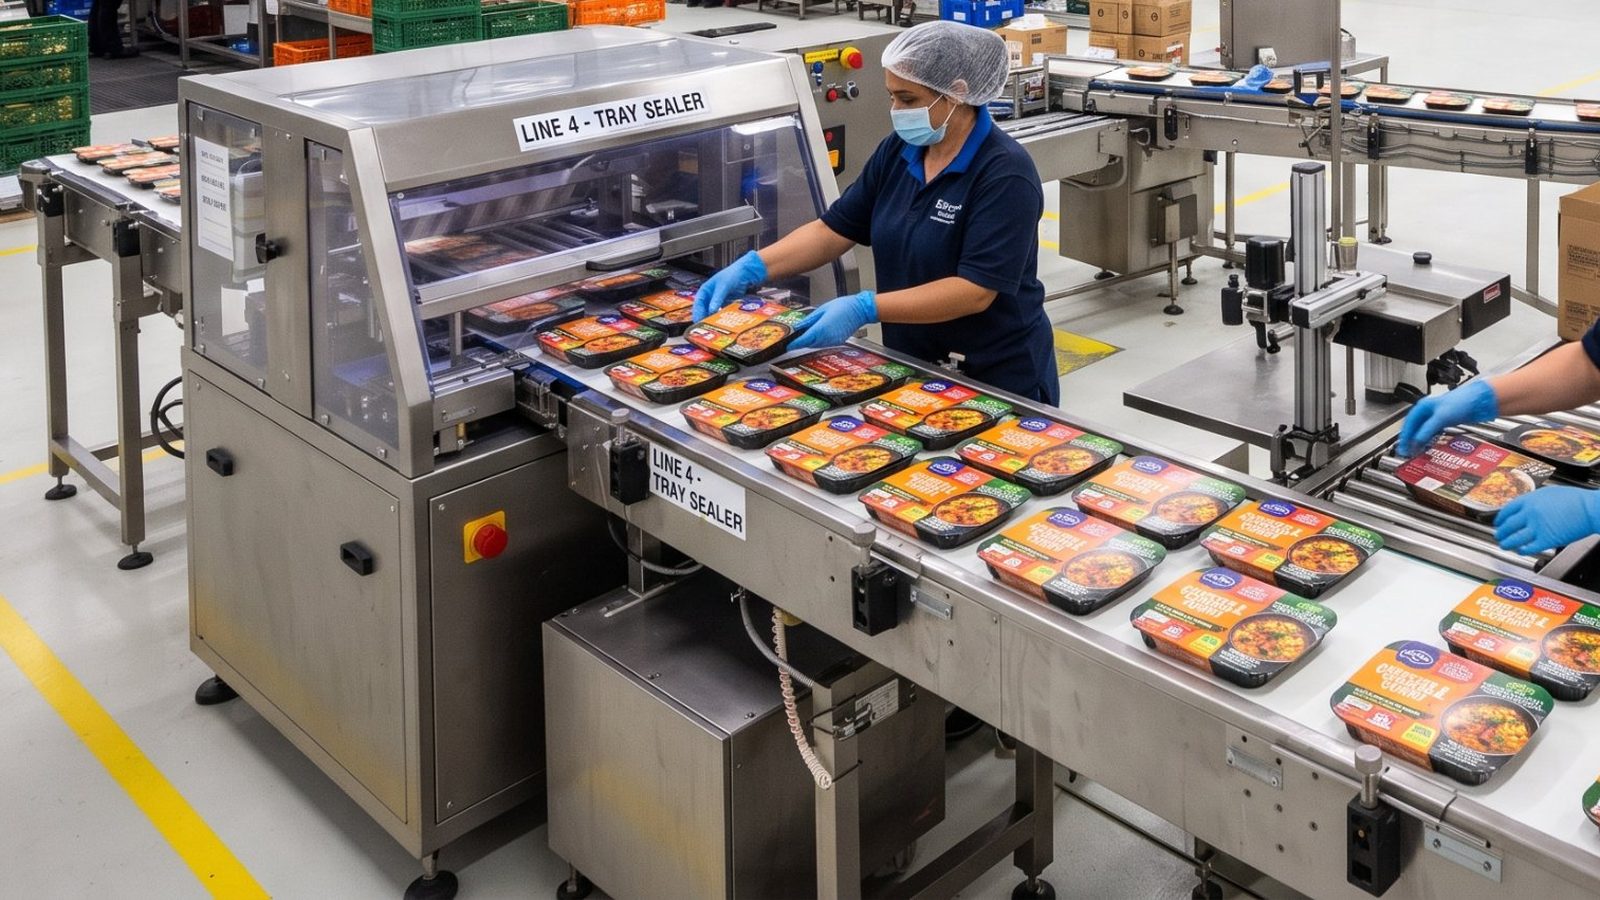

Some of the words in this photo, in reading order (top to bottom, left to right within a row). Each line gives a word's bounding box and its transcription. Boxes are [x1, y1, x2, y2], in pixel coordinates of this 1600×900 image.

[521, 118, 564, 143] LINE
[568, 116, 579, 133] 4
[594, 104, 638, 128] TRAY
[643, 92, 705, 119] SEALER
[653, 448, 682, 479] LINE
[685, 465, 693, 485] 4
[653, 472, 686, 503] TRAY
[689, 491, 743, 533] SEALER
